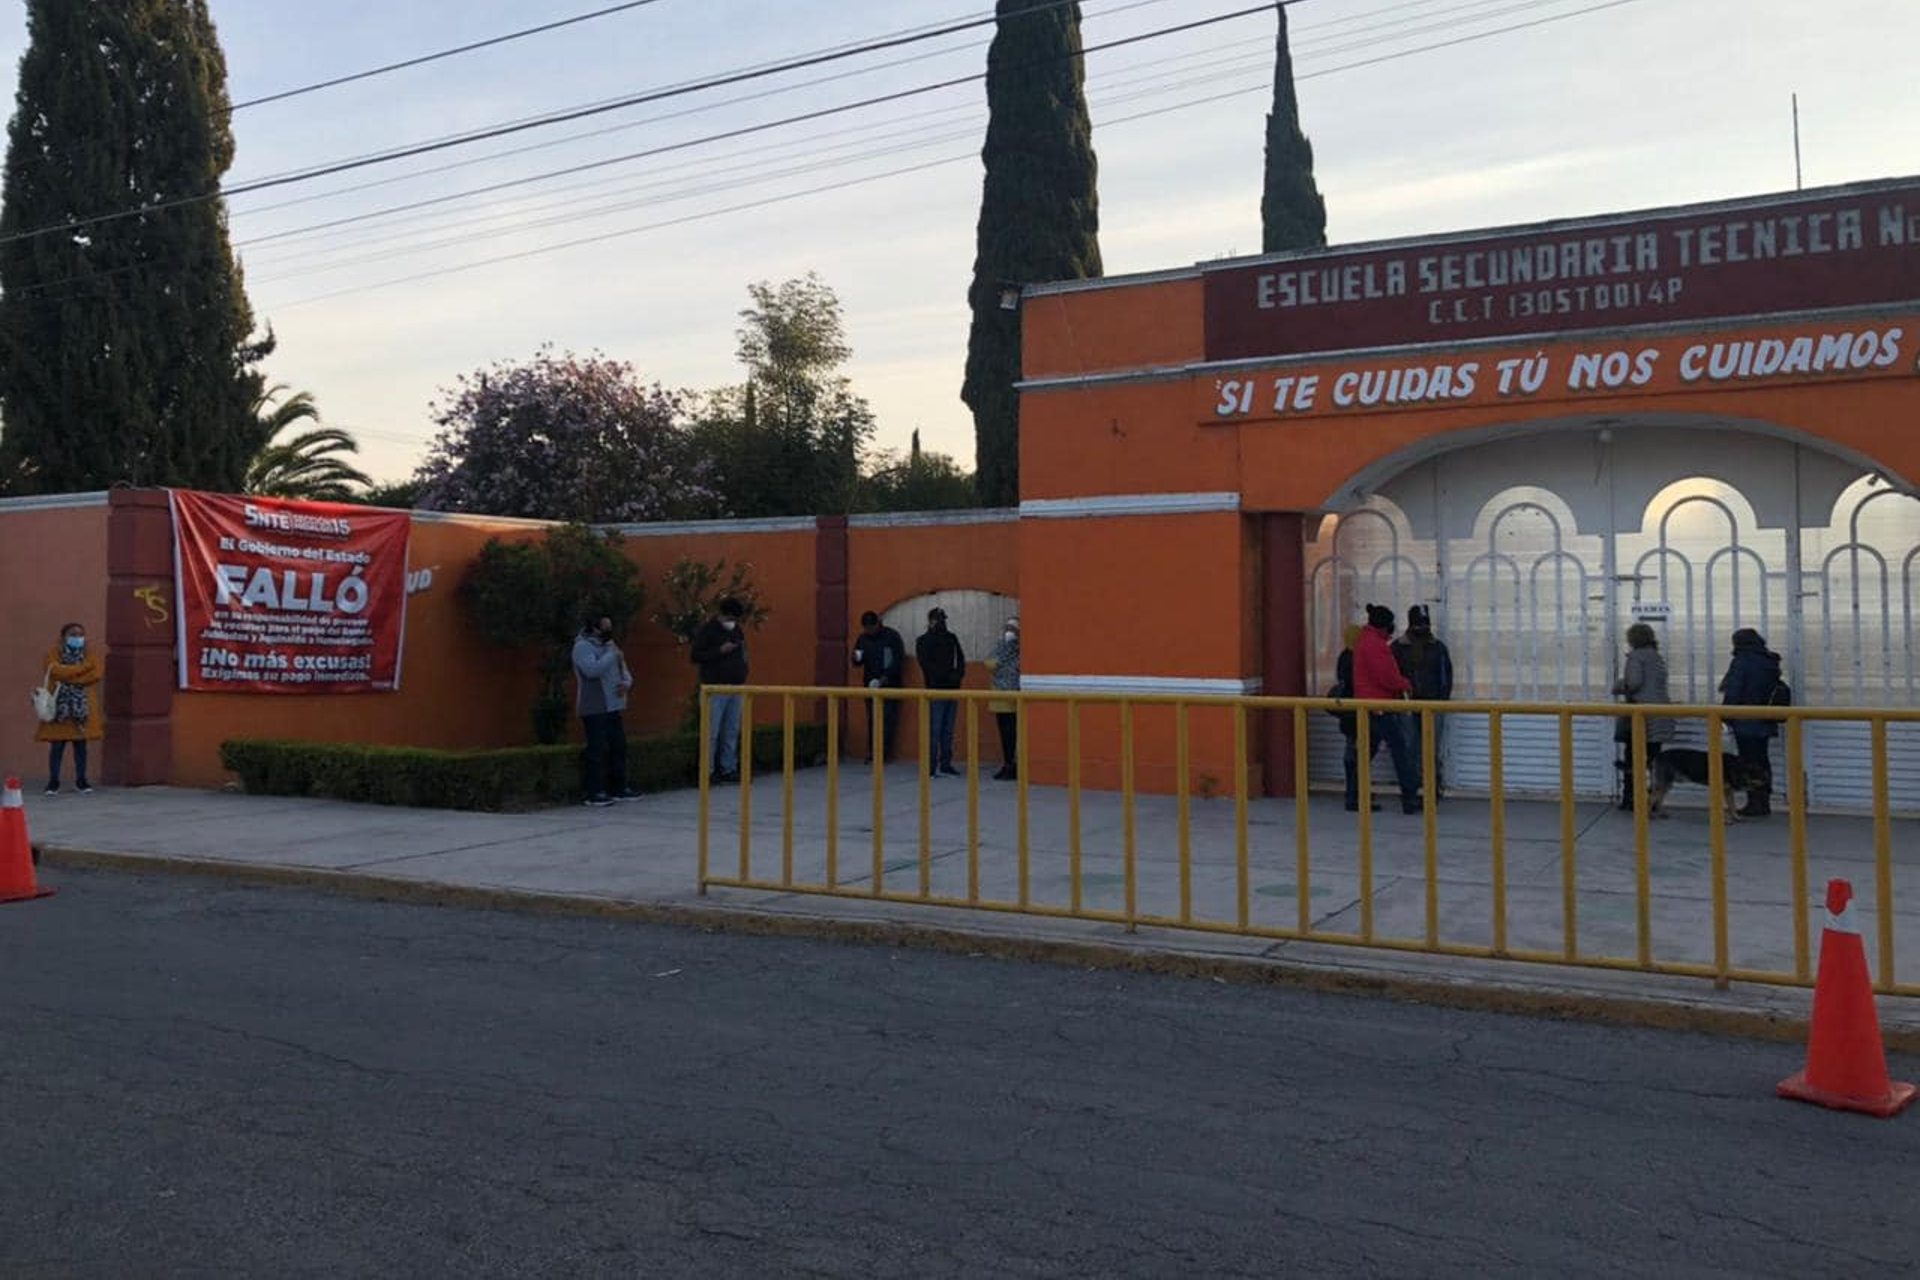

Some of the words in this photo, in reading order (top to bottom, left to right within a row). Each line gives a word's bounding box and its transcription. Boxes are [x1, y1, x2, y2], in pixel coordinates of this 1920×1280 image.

[1257, 260, 1406, 309] ESCUELA
[1417, 232, 1658, 293] SECUNDARIA
[1673, 208, 1862, 267] TECNICA
[1273, 375, 1320, 411] TE
[1333, 362, 1480, 406] CUIDAS
[1496, 351, 1549, 394] TÚ
[1567, 348, 1660, 389] NOS
[1679, 327, 1904, 380] CUIDAMOS
[238, 538, 300, 559] Gobierno
[303, 546, 324, 559] del
[326, 549, 371, 565] Estado
[214, 563, 369, 615] FALLÓ
[244, 650, 289, 670] más
[293, 654, 372, 669] excusas!
